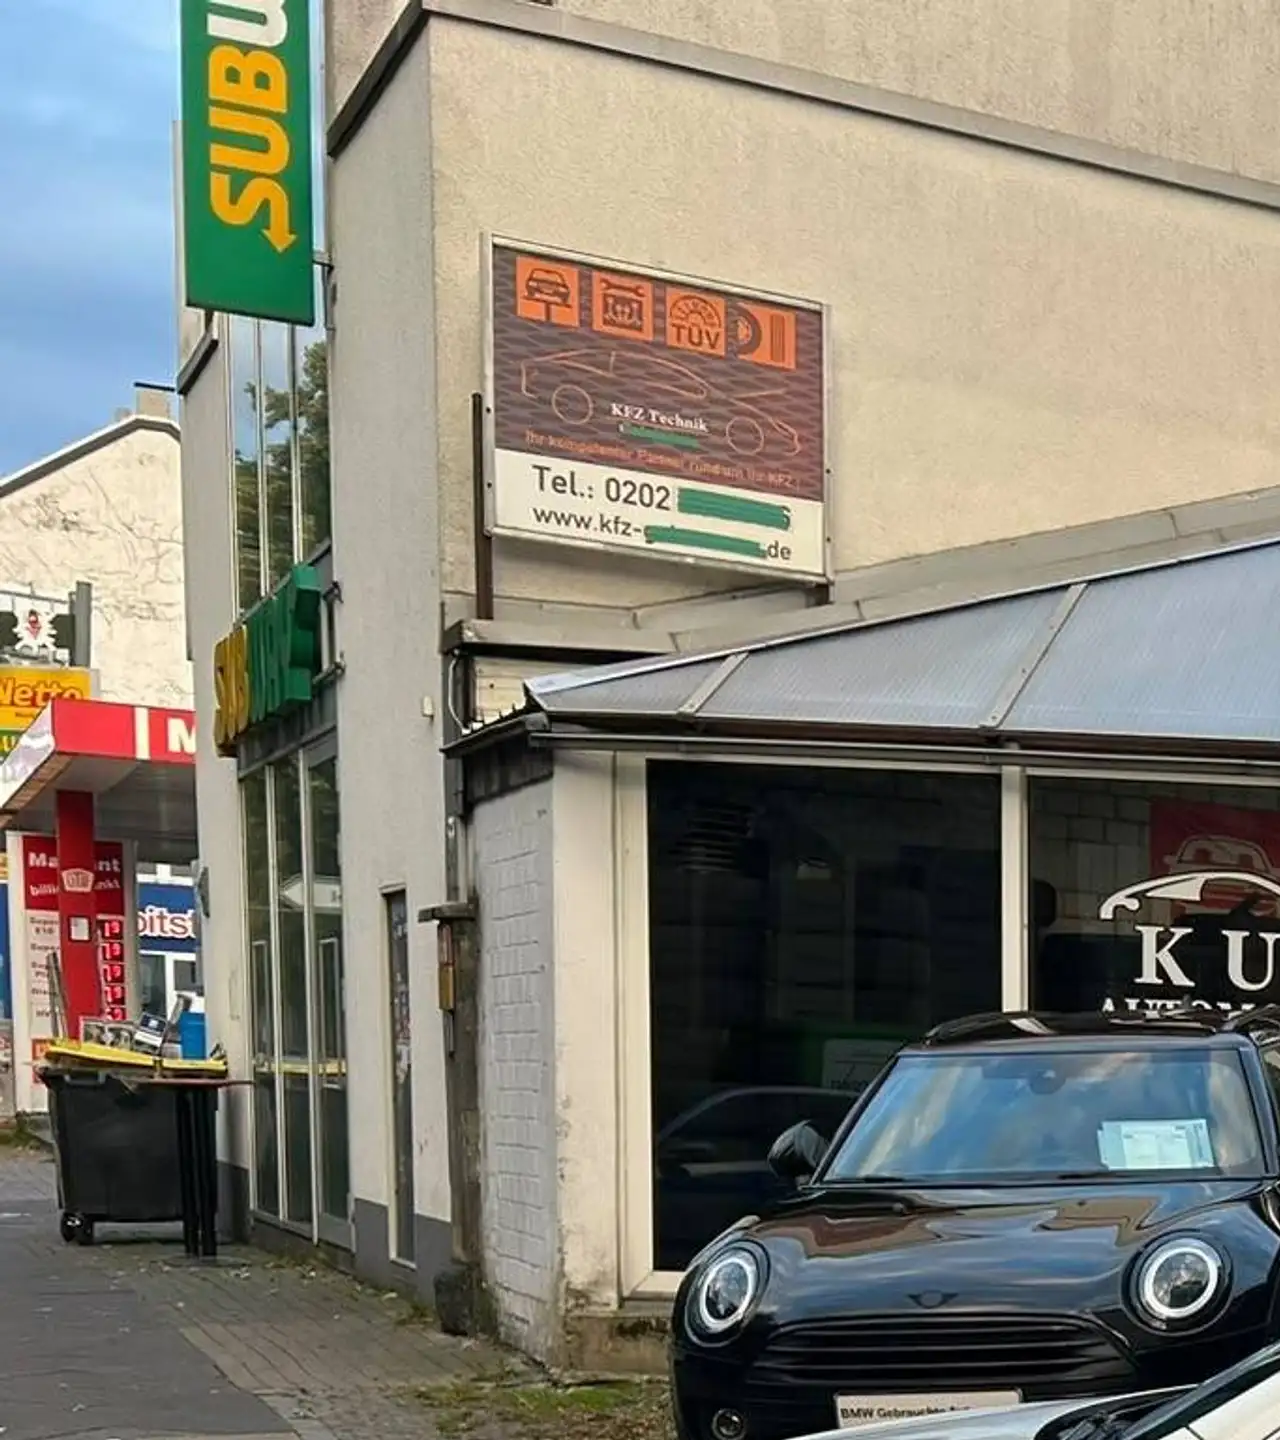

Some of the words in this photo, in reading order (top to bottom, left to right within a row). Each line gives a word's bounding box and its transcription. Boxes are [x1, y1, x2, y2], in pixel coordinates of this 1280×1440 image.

[610, 403, 647, 421] KFZ
[648, 408, 710, 433] Technik
[532, 464, 594, 500] Tel.:
[605, 477, 671, 511] 0202
[28, 852, 121, 873] Mant
[840, 1407, 874, 1419] BMW
